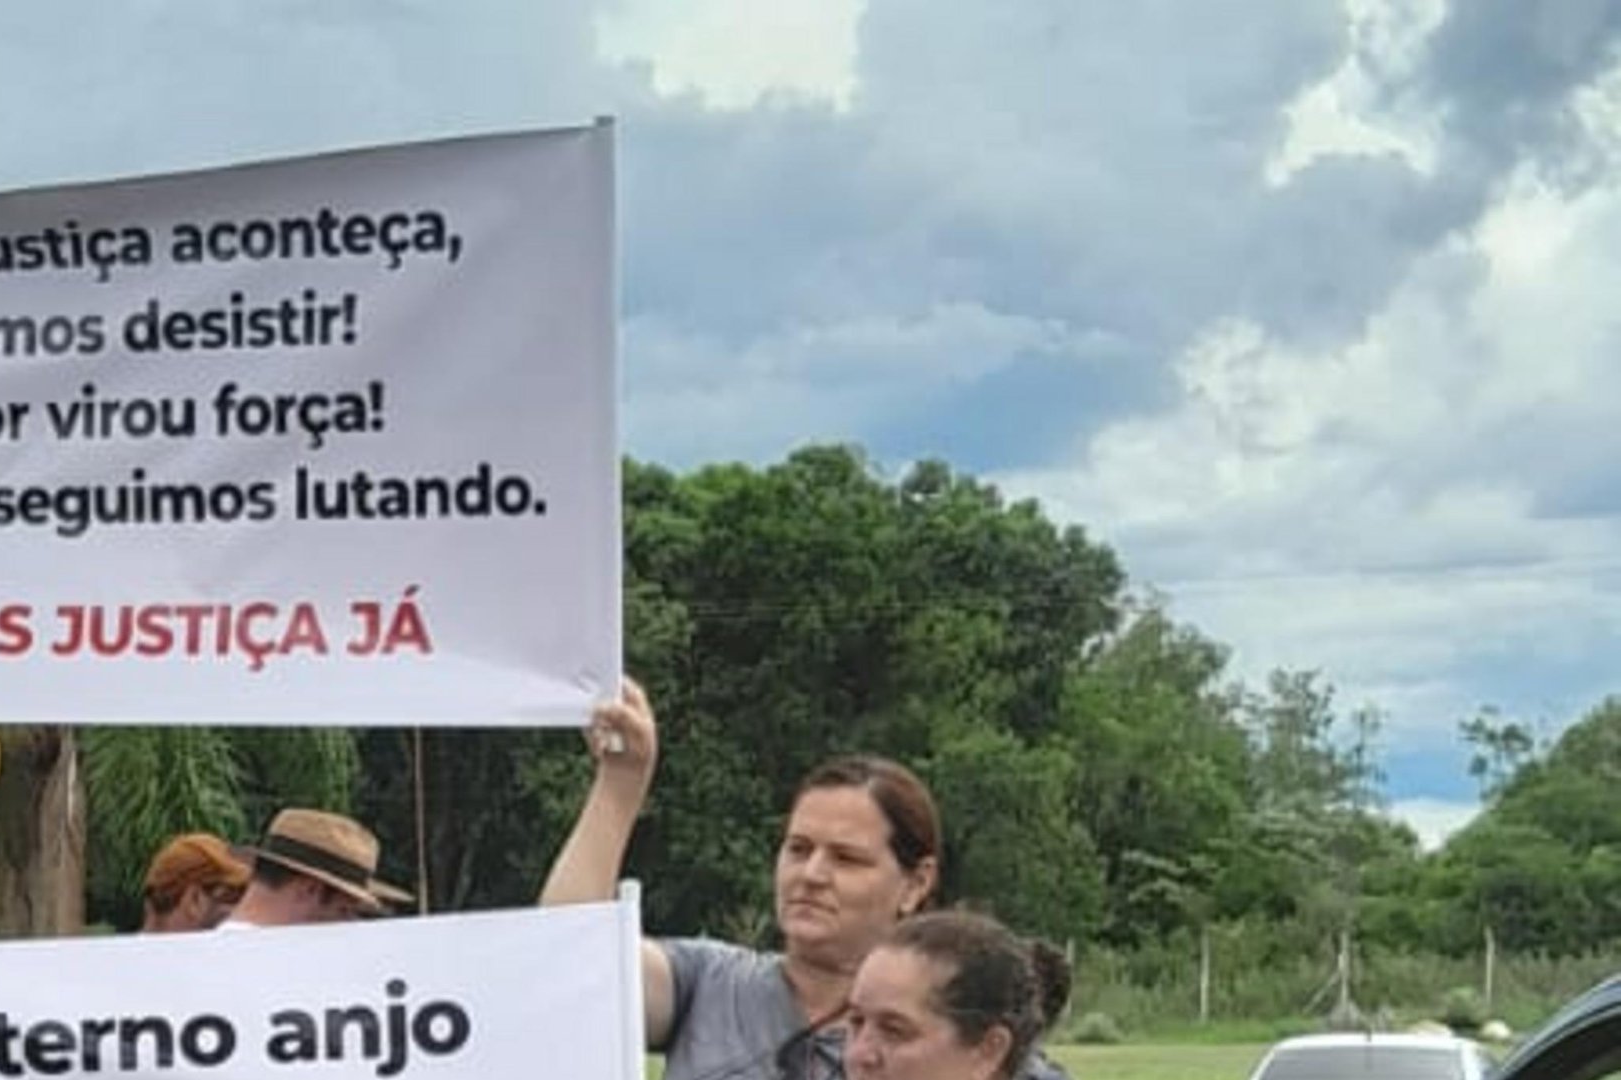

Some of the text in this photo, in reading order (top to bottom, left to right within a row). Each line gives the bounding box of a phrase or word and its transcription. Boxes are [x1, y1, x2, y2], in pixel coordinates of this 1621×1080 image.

[169, 203, 464, 272] aconteça,
[121, 287, 359, 355] desistir!
[44, 380, 198, 441] virou
[211, 379, 386, 452] força!
[294, 461, 548, 521] lutando.
[49, 600, 330, 672] JUSTIÇA
[346, 584, 434, 657] JÁ
[264, 977, 472, 1079] anjo
